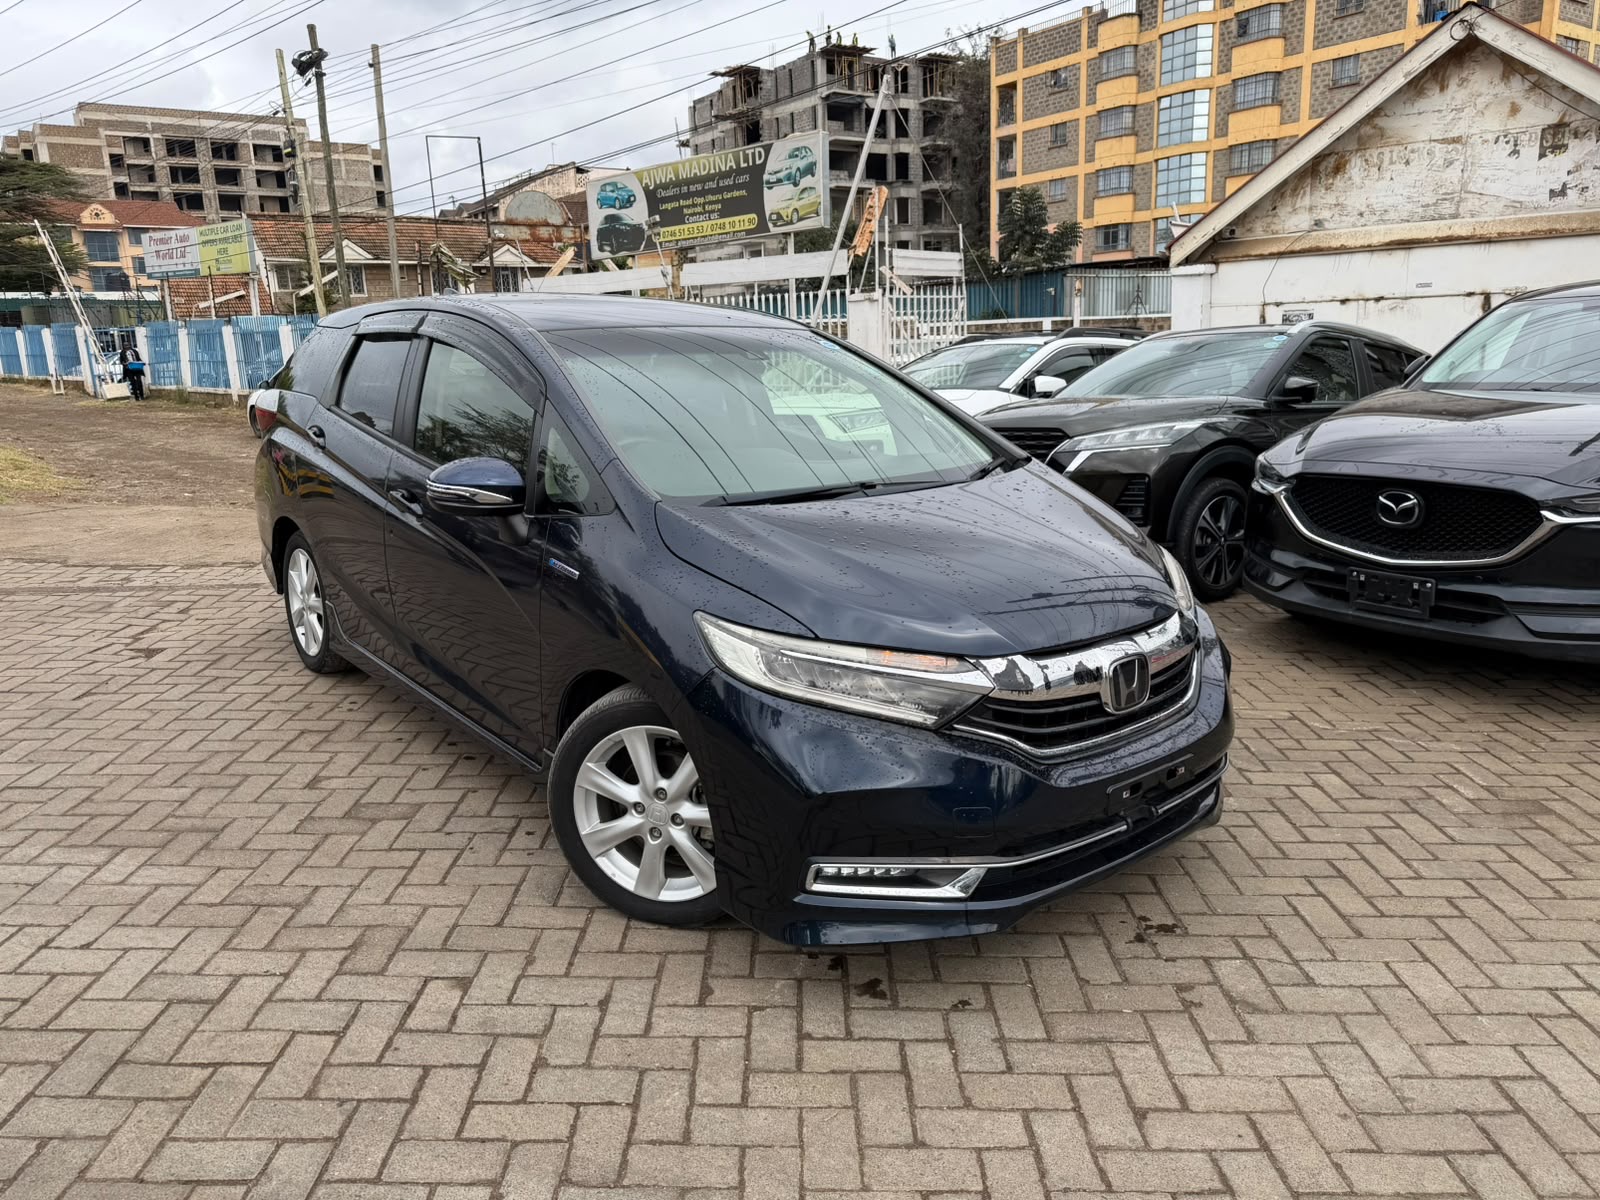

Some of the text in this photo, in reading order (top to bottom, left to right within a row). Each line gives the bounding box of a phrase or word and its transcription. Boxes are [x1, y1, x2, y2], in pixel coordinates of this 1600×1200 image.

[642, 147, 765, 189] AJWA MADINA LTD
[656, 173, 750, 198] Dealers in new and used cars
[659, 201, 679, 210] Langata
[680, 198, 693, 206] Road
[723, 189, 748, 199] Gardens,
[683, 203, 722, 214] Nairobi, Kenya
[685, 213, 709, 223] Contact
[199, 223, 243, 237] MULTIPLE CAR LOAN
[662, 229, 677, 239] 0746
[678, 228, 685, 237] 51
[687, 226, 695, 235] 53
[696, 225, 704, 234] 53
[710, 222, 726, 232] 0748
[728, 220, 736, 229] 10
[738, 219, 745, 228] 11
[747, 217, 756, 226] 90
[148, 232, 190, 247] Premier Auto
[202, 234, 243, 248] OFFERS AVAILABLE
[155, 246, 186, 260] World Ltd
[217, 246, 229, 256] HERE
